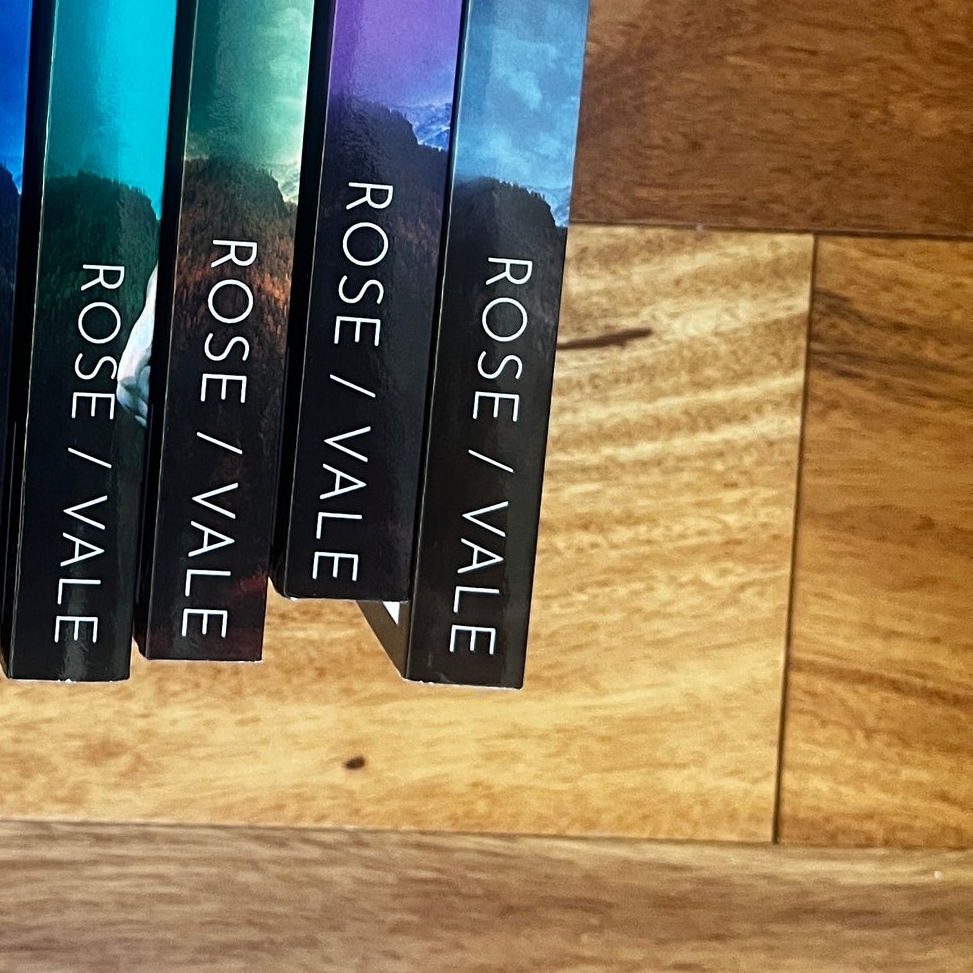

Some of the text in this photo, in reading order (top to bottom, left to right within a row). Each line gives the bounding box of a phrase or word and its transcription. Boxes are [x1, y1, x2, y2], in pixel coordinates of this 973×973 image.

[71, 263, 125, 421] ROSE
[200, 240, 258, 404] ROSE
[333, 181, 394, 347] ROSE
[472, 256, 533, 424] ROSE
[53, 495, 107, 644] VALE
[182, 482, 239, 639] VALE
[312, 426, 372, 584] VALE
[449, 501, 509, 657] VALE
